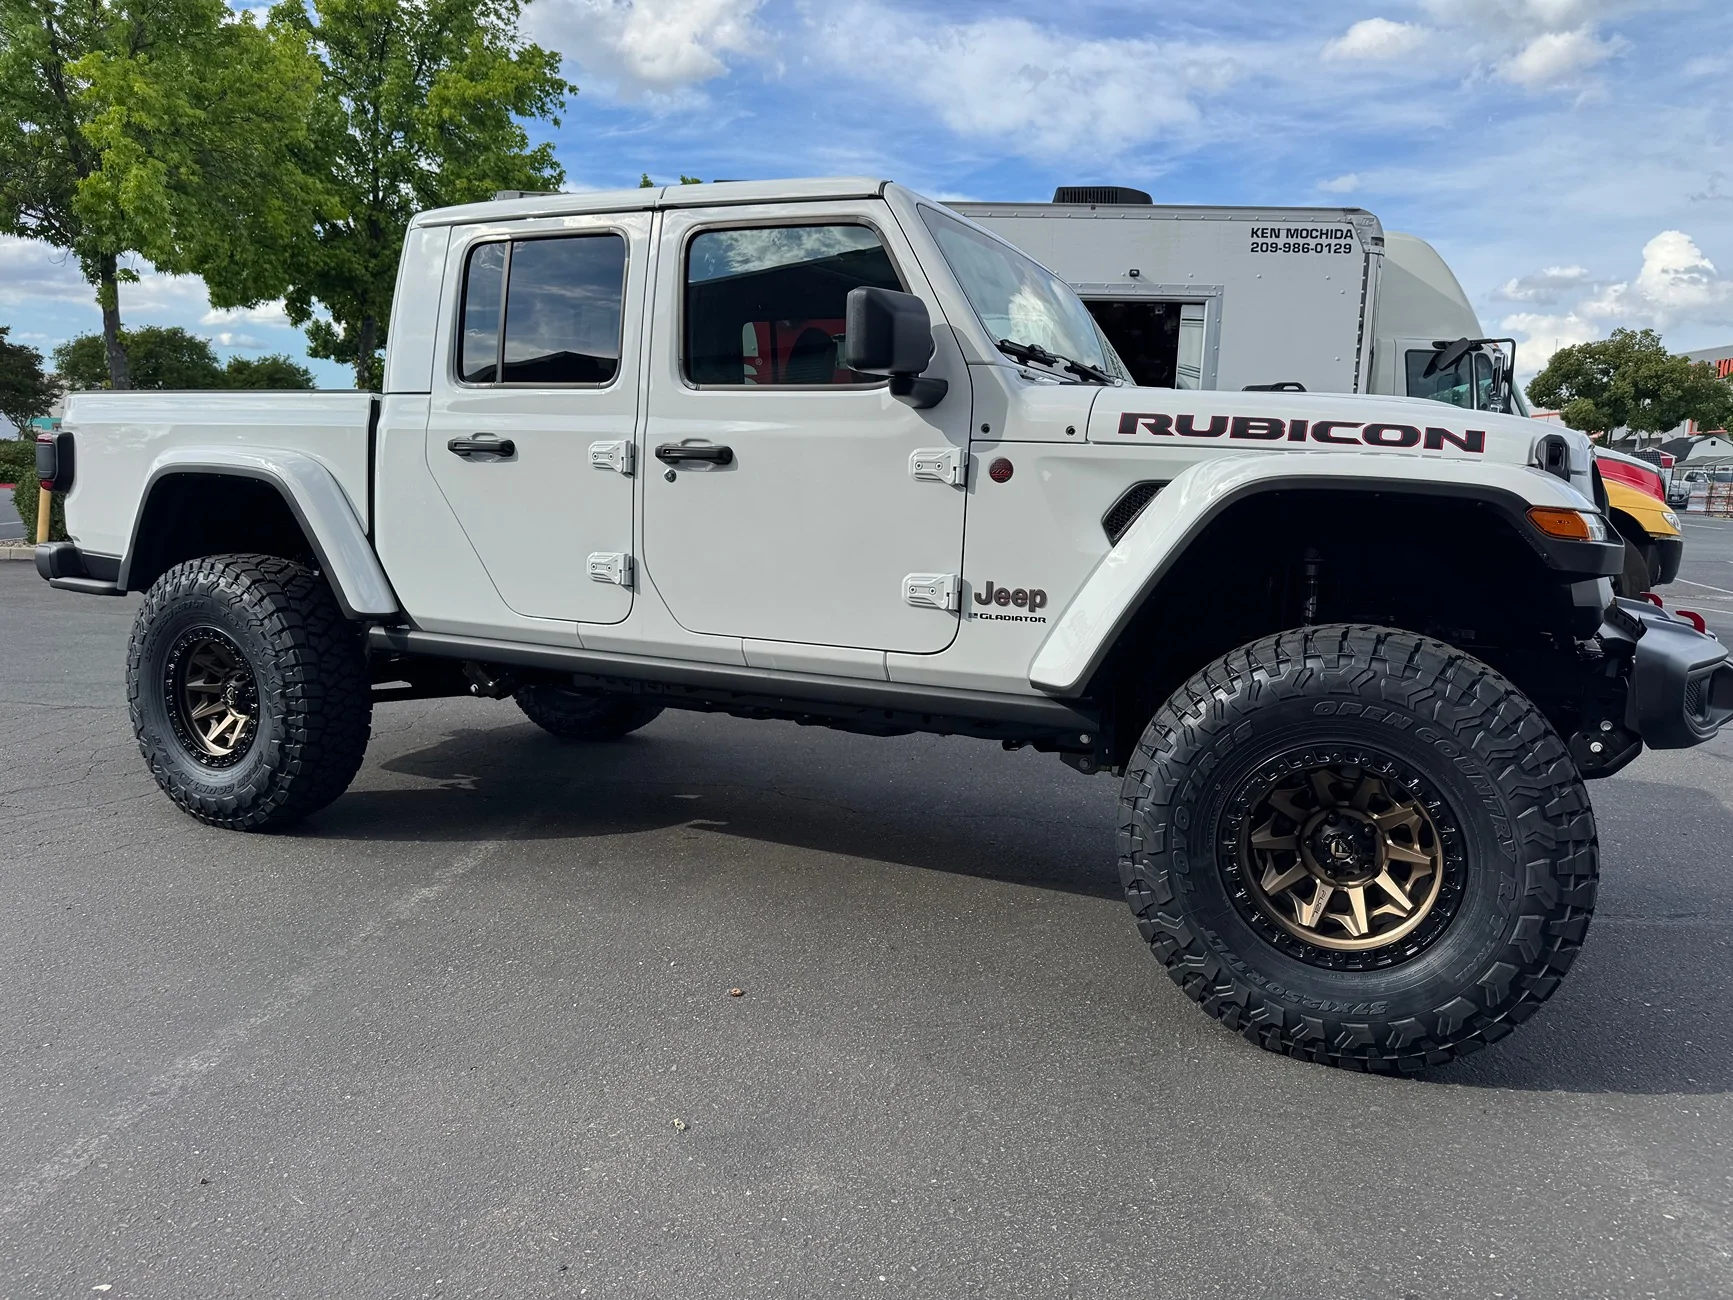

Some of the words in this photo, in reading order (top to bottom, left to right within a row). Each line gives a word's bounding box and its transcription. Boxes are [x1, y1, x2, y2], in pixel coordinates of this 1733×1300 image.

[1250, 227, 1281, 239] KEN
[1285, 228, 1354, 240] MOCHIDA
[1250, 241, 1352, 254] 209-986-0129
[1117, 411, 1486, 453] RUBICON
[973, 580, 1048, 613] Jeep
[979, 612, 1047, 624] GLADIATOR
[1180, 719, 1255, 804] TIRES
[1312, 700, 1414, 730] OPEN
[1414, 726, 1517, 864] COUNTRY
[1172, 805, 1195, 894] TOYO
